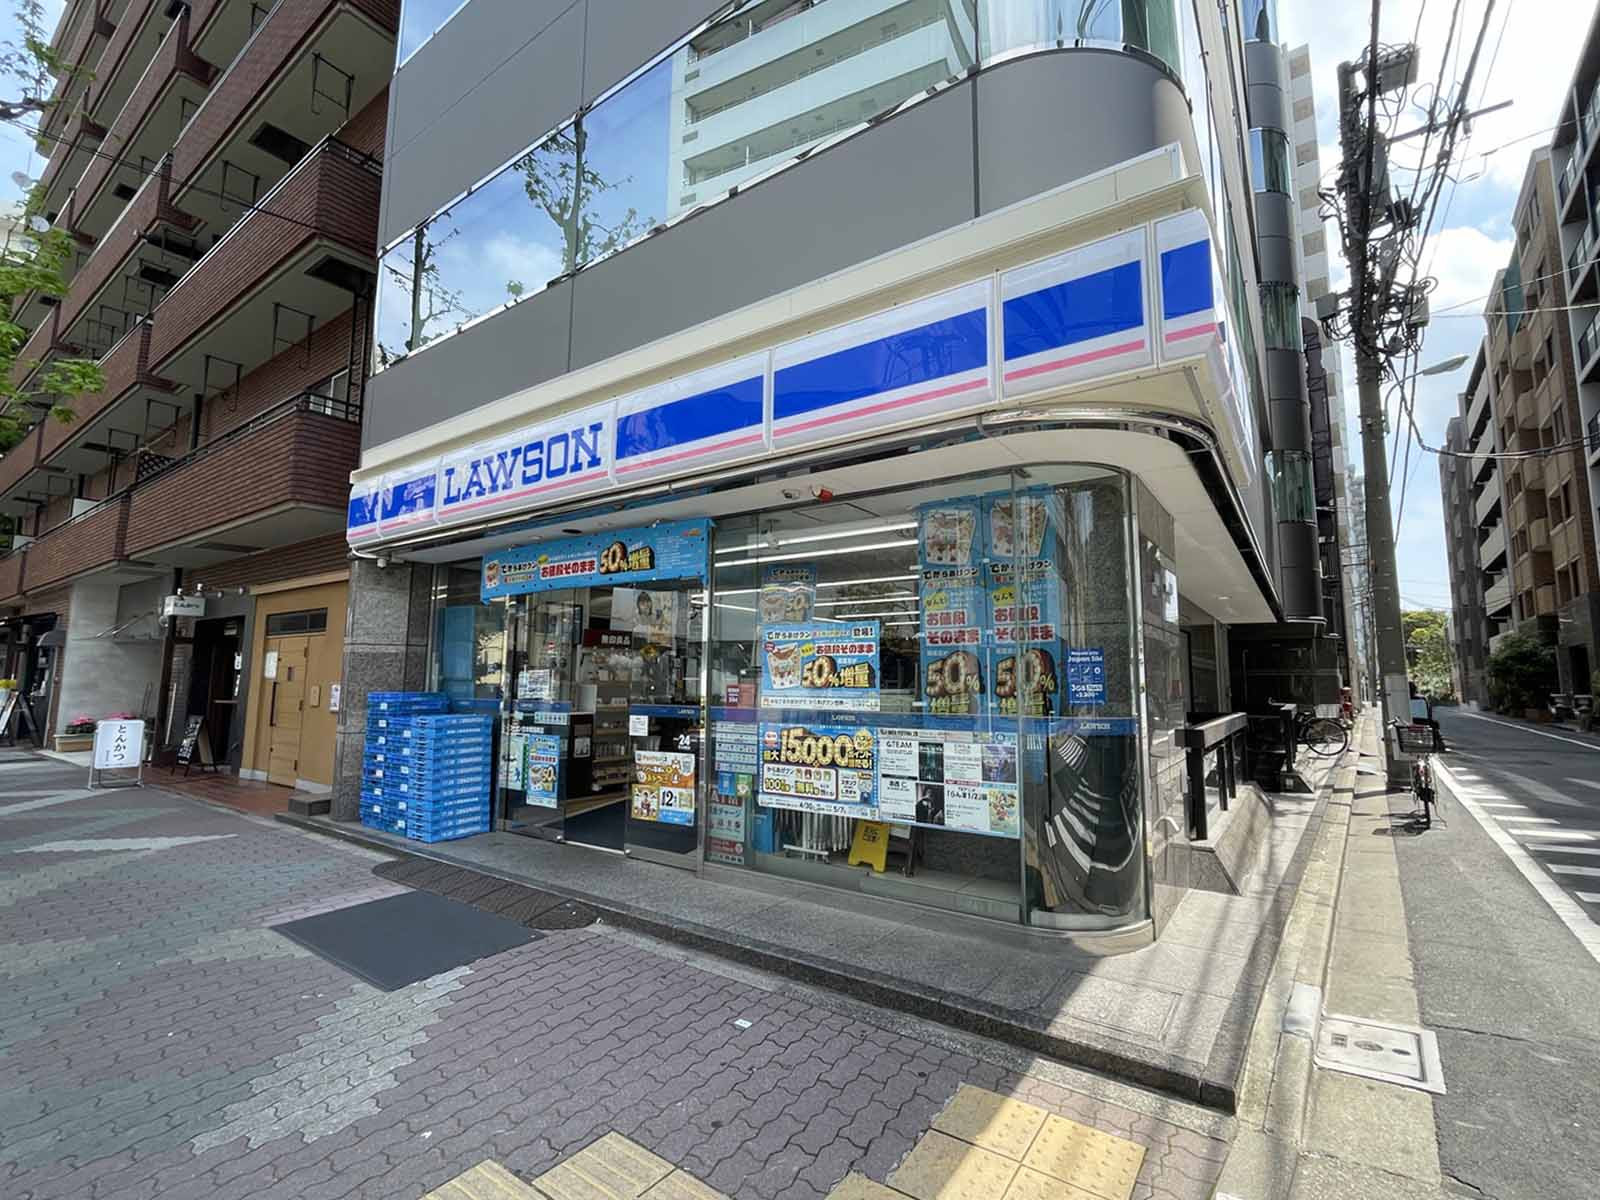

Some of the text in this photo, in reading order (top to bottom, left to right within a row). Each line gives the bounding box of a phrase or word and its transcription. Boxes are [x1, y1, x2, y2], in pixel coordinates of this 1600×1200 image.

[443, 421, 604, 506] LAWSON
[926, 629, 980, 645] そのまま
[112, 724, 129, 761] とんかつ
[679, 734, 691, 746] 24
